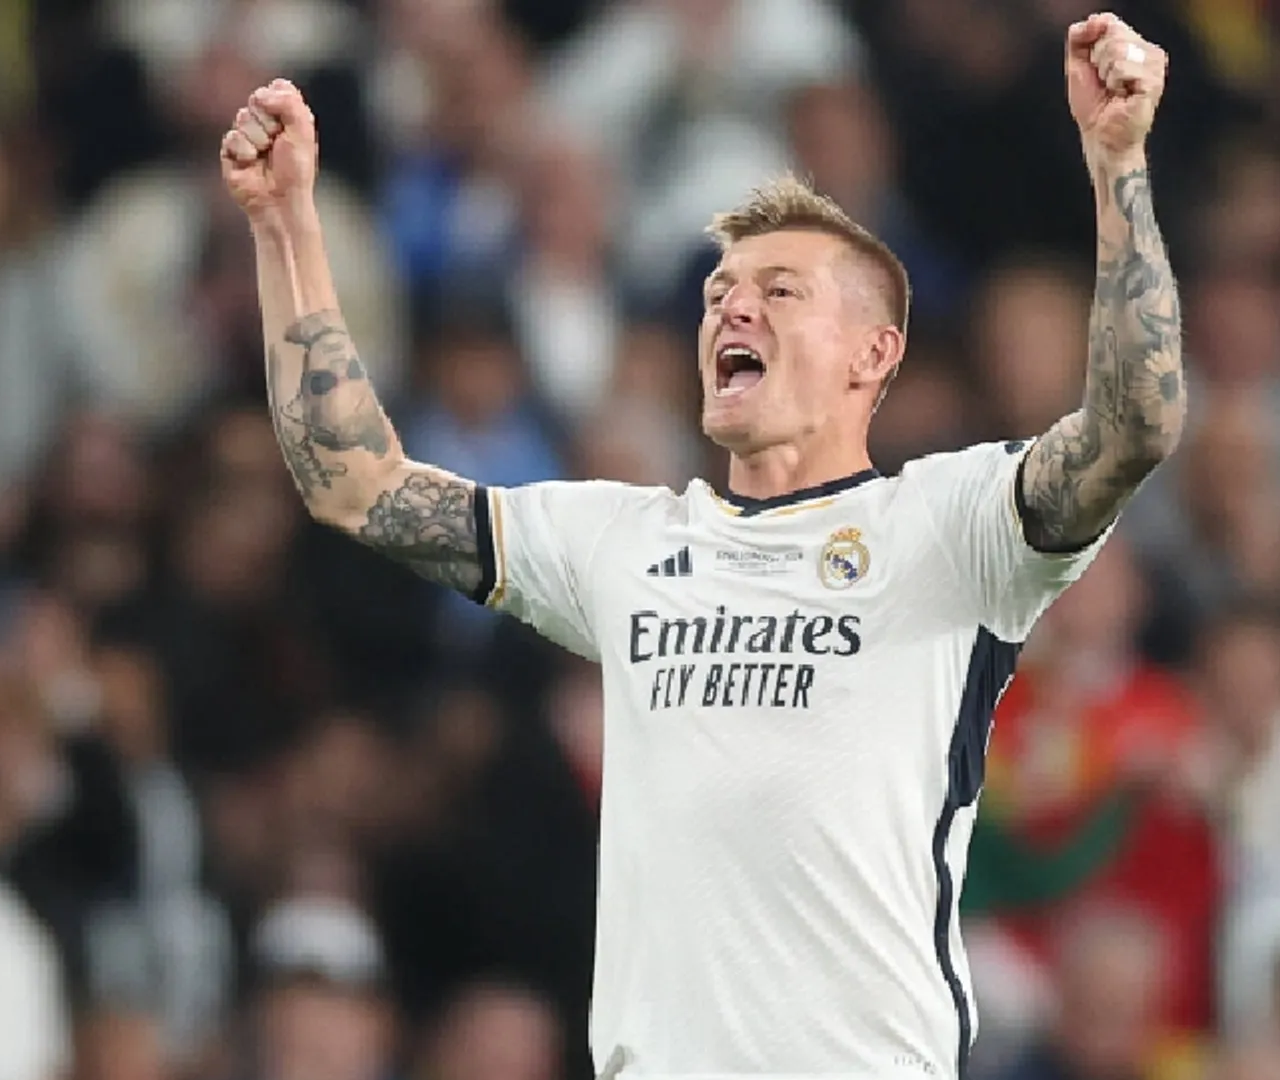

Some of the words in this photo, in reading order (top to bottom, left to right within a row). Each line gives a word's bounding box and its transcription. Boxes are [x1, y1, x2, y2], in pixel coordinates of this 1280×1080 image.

[629, 604, 862, 664] Emirates
[650, 664, 696, 711] FLY
[701, 662, 815, 709] BETTER
